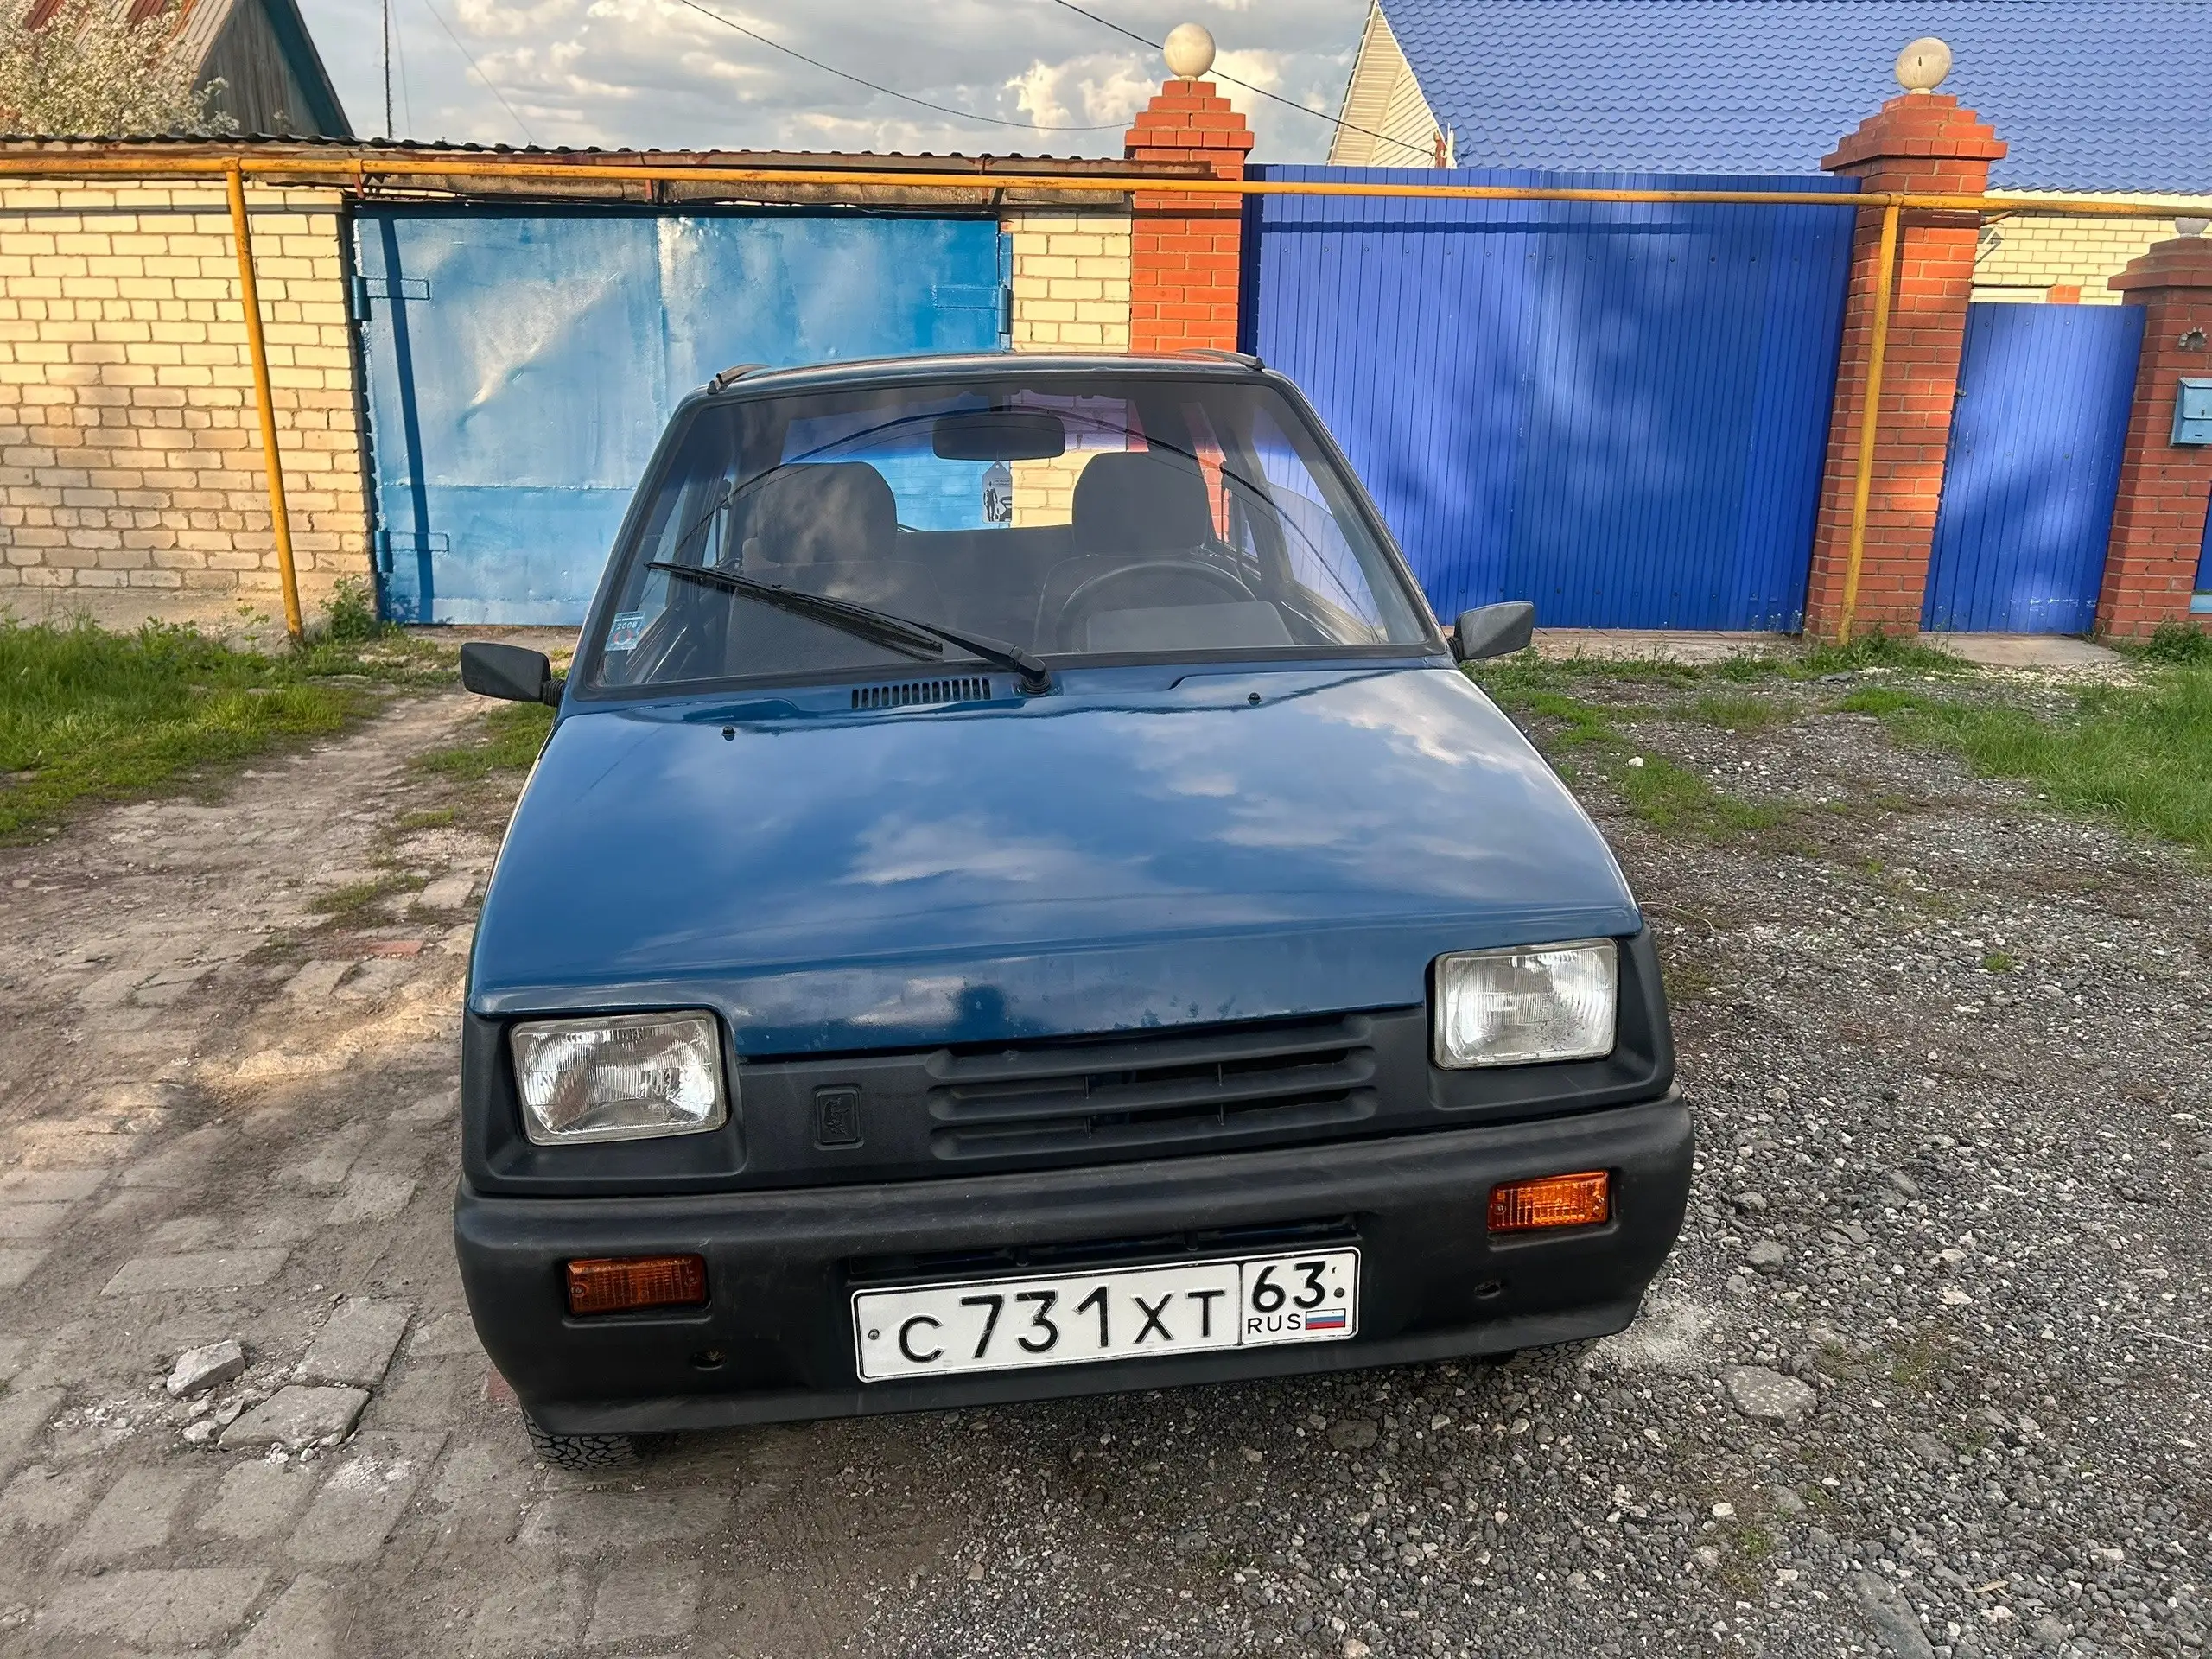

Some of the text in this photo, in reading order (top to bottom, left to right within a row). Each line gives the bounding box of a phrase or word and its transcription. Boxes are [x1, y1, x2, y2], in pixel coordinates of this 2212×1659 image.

[616, 621, 637, 630] 2008
[1250, 1260, 1326, 1313] 63
[1247, 1313, 1301, 1335] RUS
